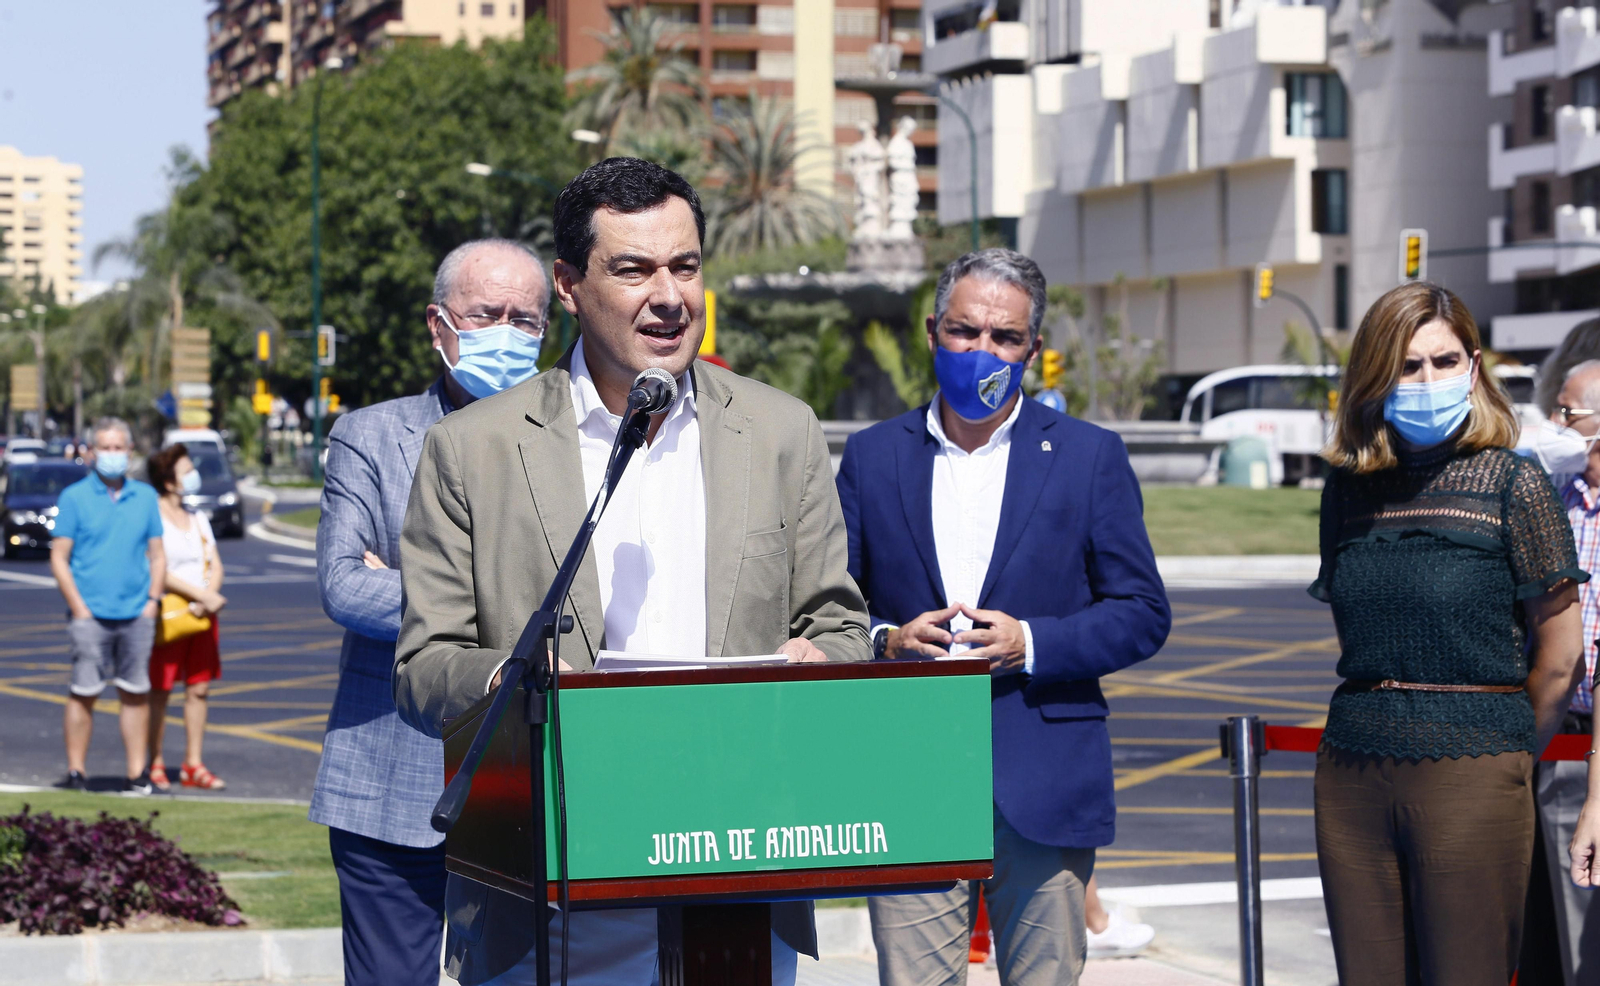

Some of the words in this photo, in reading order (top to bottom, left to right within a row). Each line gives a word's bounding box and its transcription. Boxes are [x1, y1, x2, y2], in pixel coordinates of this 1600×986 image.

[647, 830, 720, 865] JUNTA
[727, 828, 757, 861] DE
[765, 822, 888, 859] ANDALUCIA
